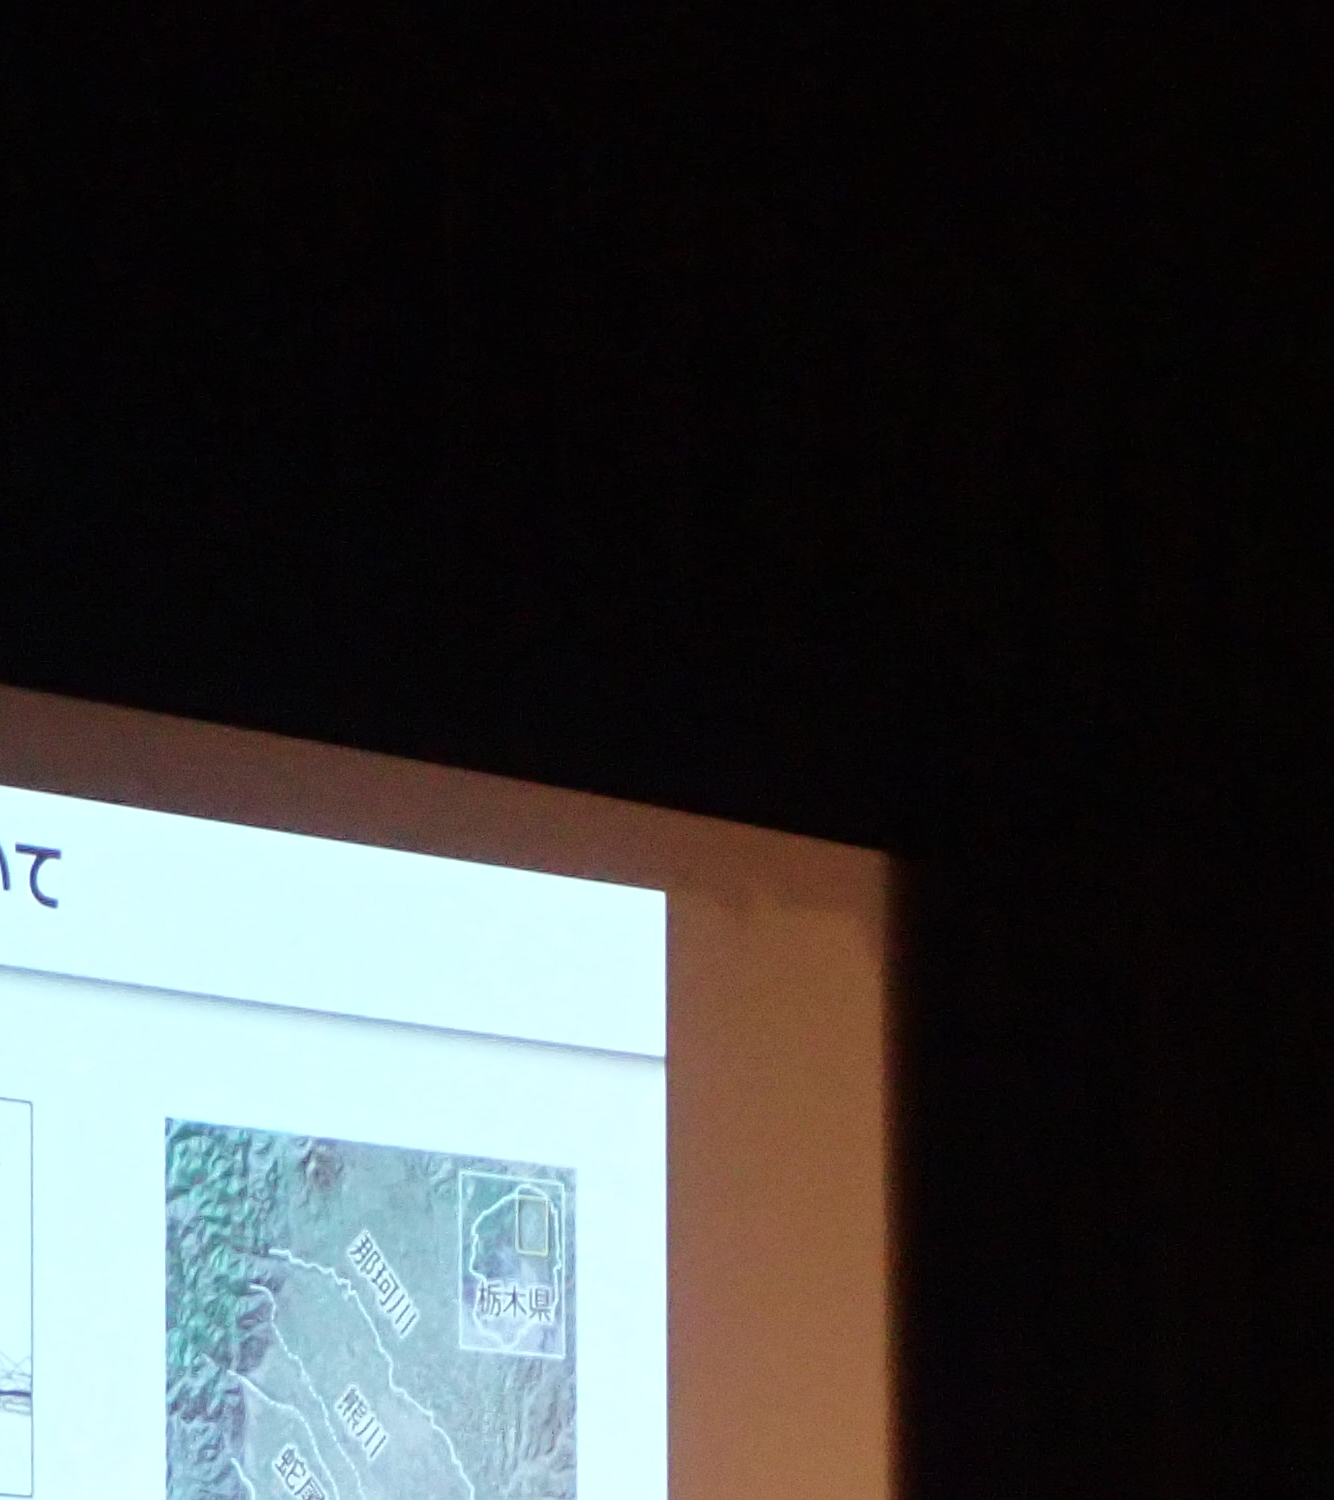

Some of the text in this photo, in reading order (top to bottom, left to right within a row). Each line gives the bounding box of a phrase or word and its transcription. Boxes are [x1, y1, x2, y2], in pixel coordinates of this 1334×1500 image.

[349, 1235, 418, 1336] 那珂川
[478, 1281, 551, 1321] 栃木県
